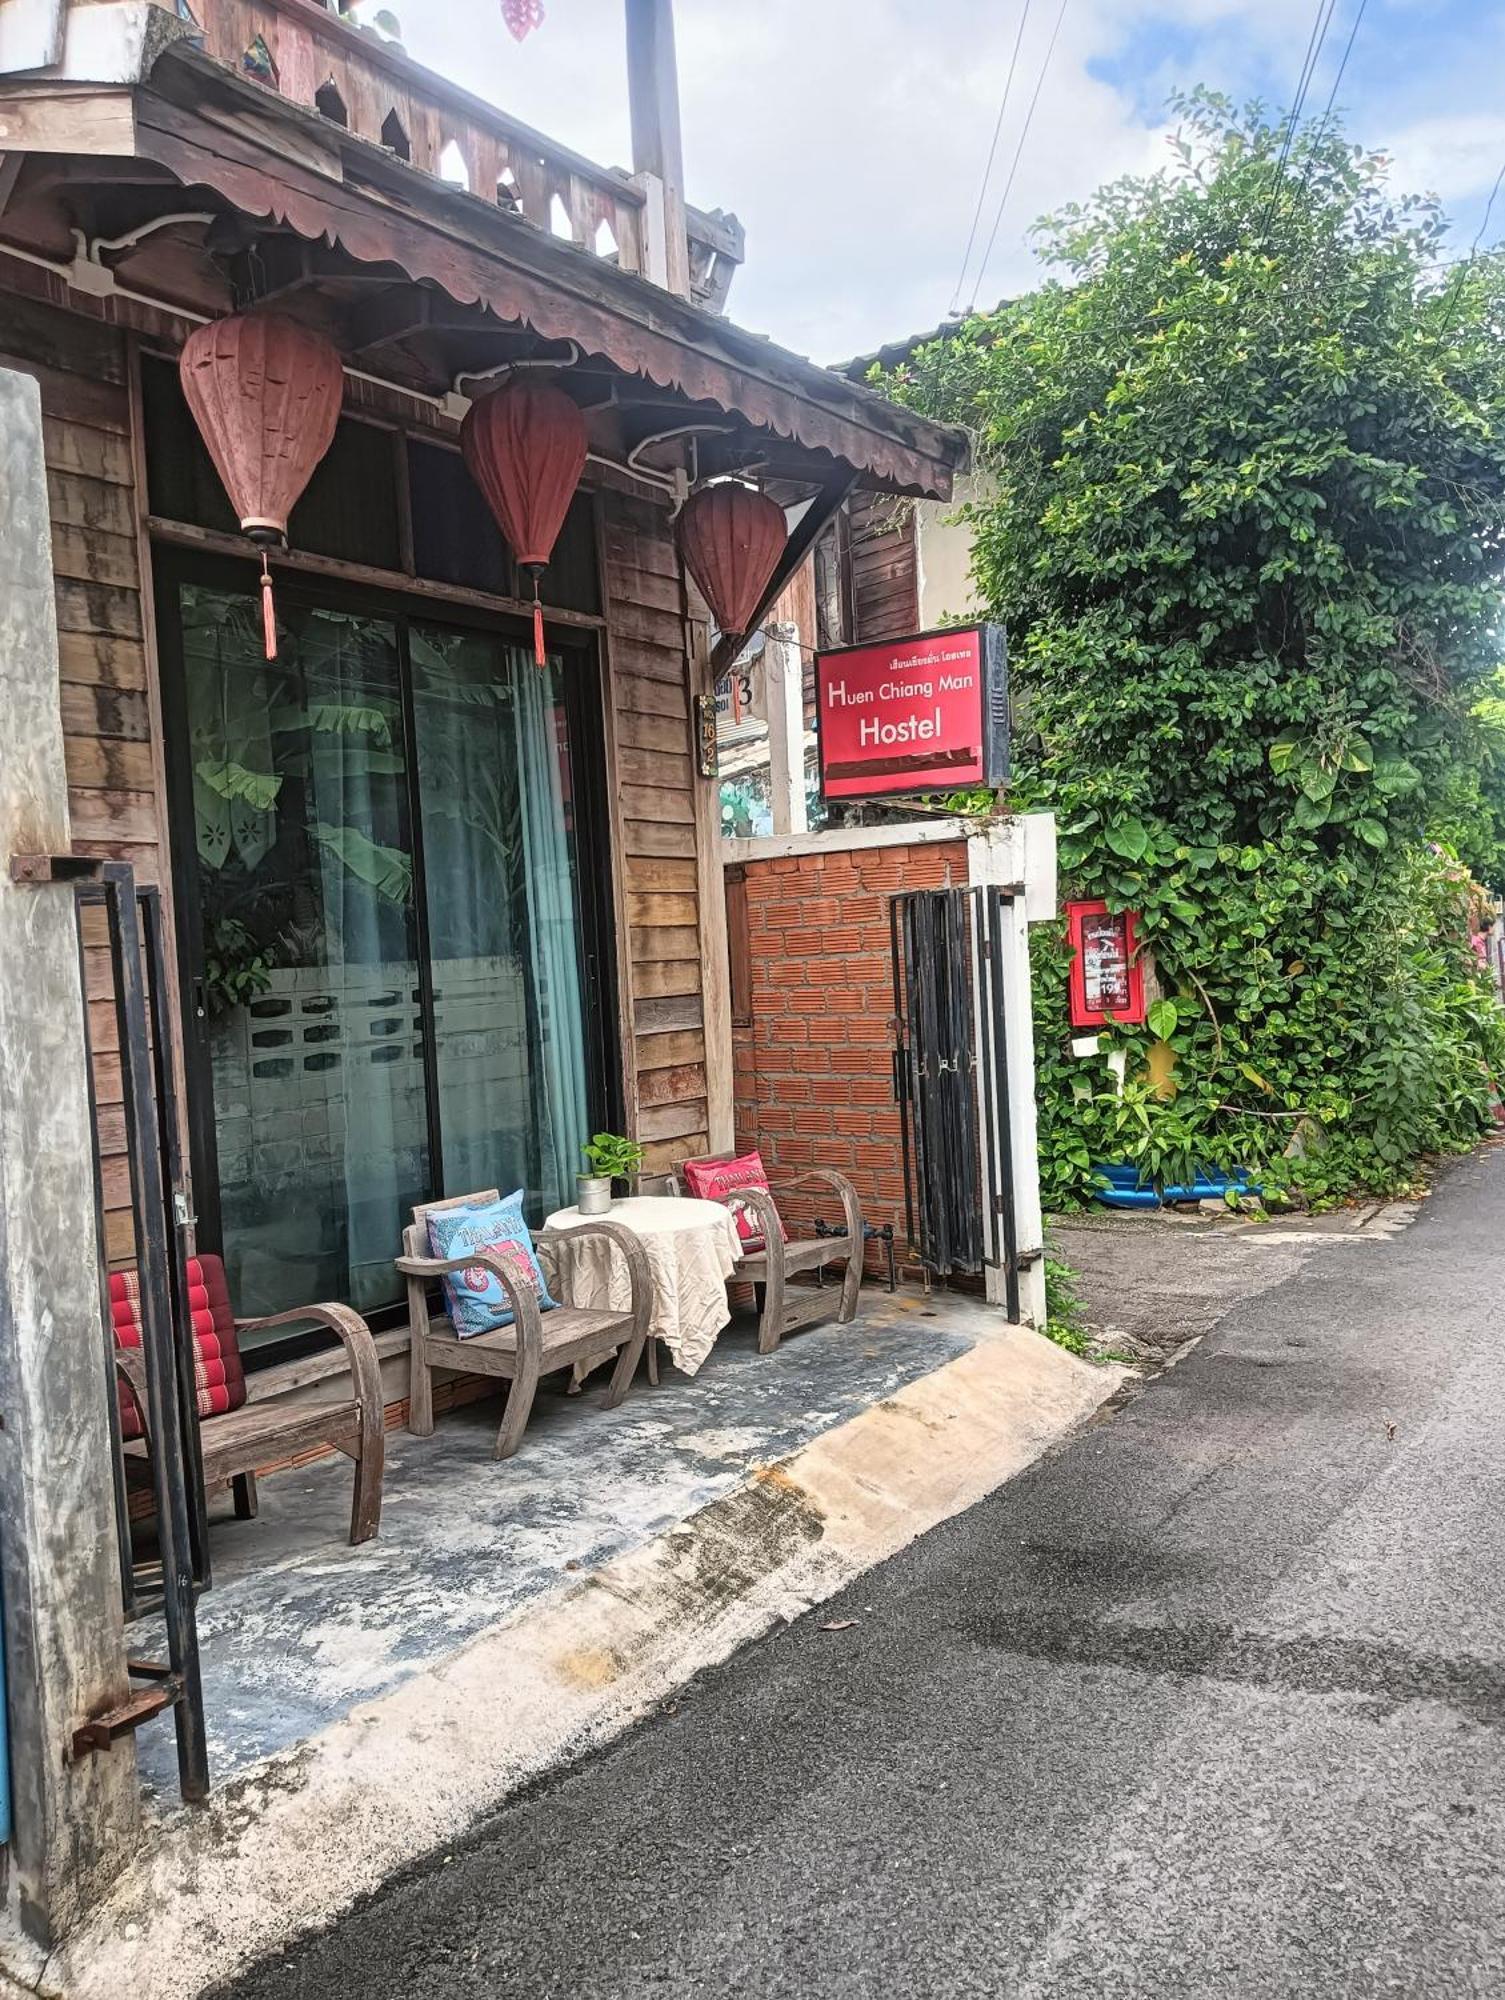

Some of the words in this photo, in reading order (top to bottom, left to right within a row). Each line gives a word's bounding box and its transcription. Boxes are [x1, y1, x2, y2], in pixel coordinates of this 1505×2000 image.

[738, 677, 753, 706] 3
[828, 680, 874, 708] Huen
[879, 681, 933, 699] Chiang
[939, 675, 973, 692] Man
[860, 707, 941, 746] Hostel
